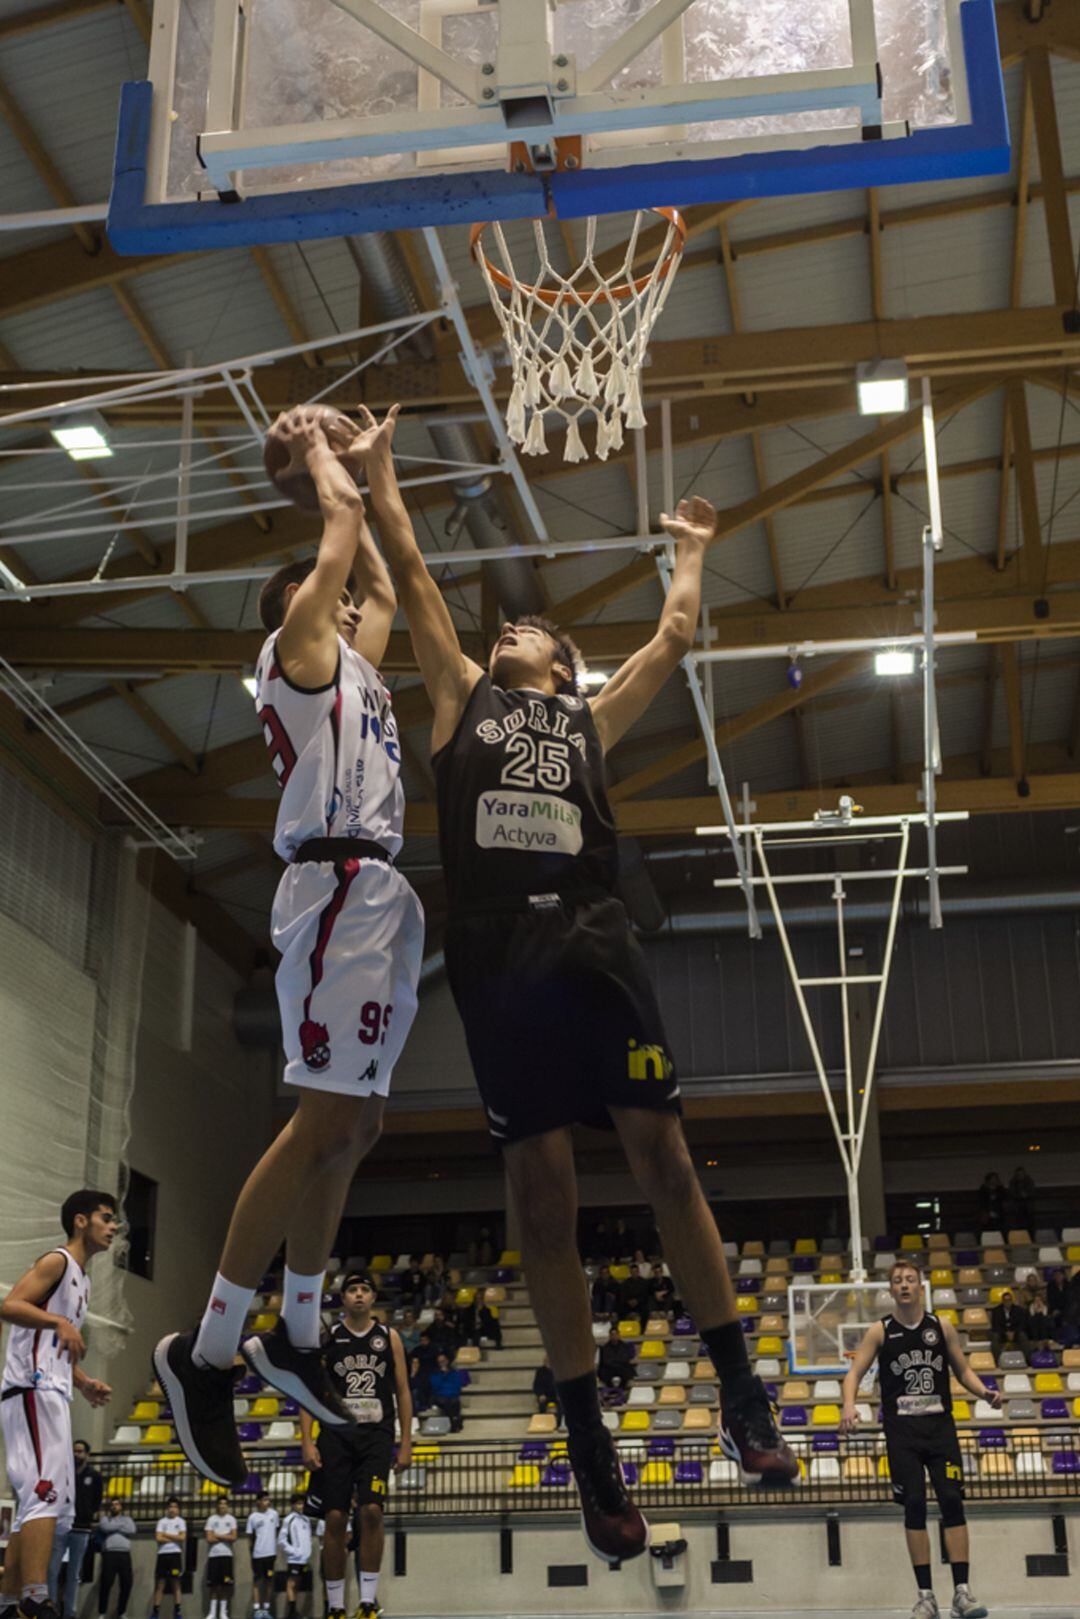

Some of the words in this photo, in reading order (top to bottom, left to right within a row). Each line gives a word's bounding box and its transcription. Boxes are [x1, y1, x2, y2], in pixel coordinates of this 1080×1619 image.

[501, 732, 571, 792] 25
[493, 824, 557, 847] Actyva
[346, 1371, 376, 1397] 22
[904, 1367, 934, 1394] 26
